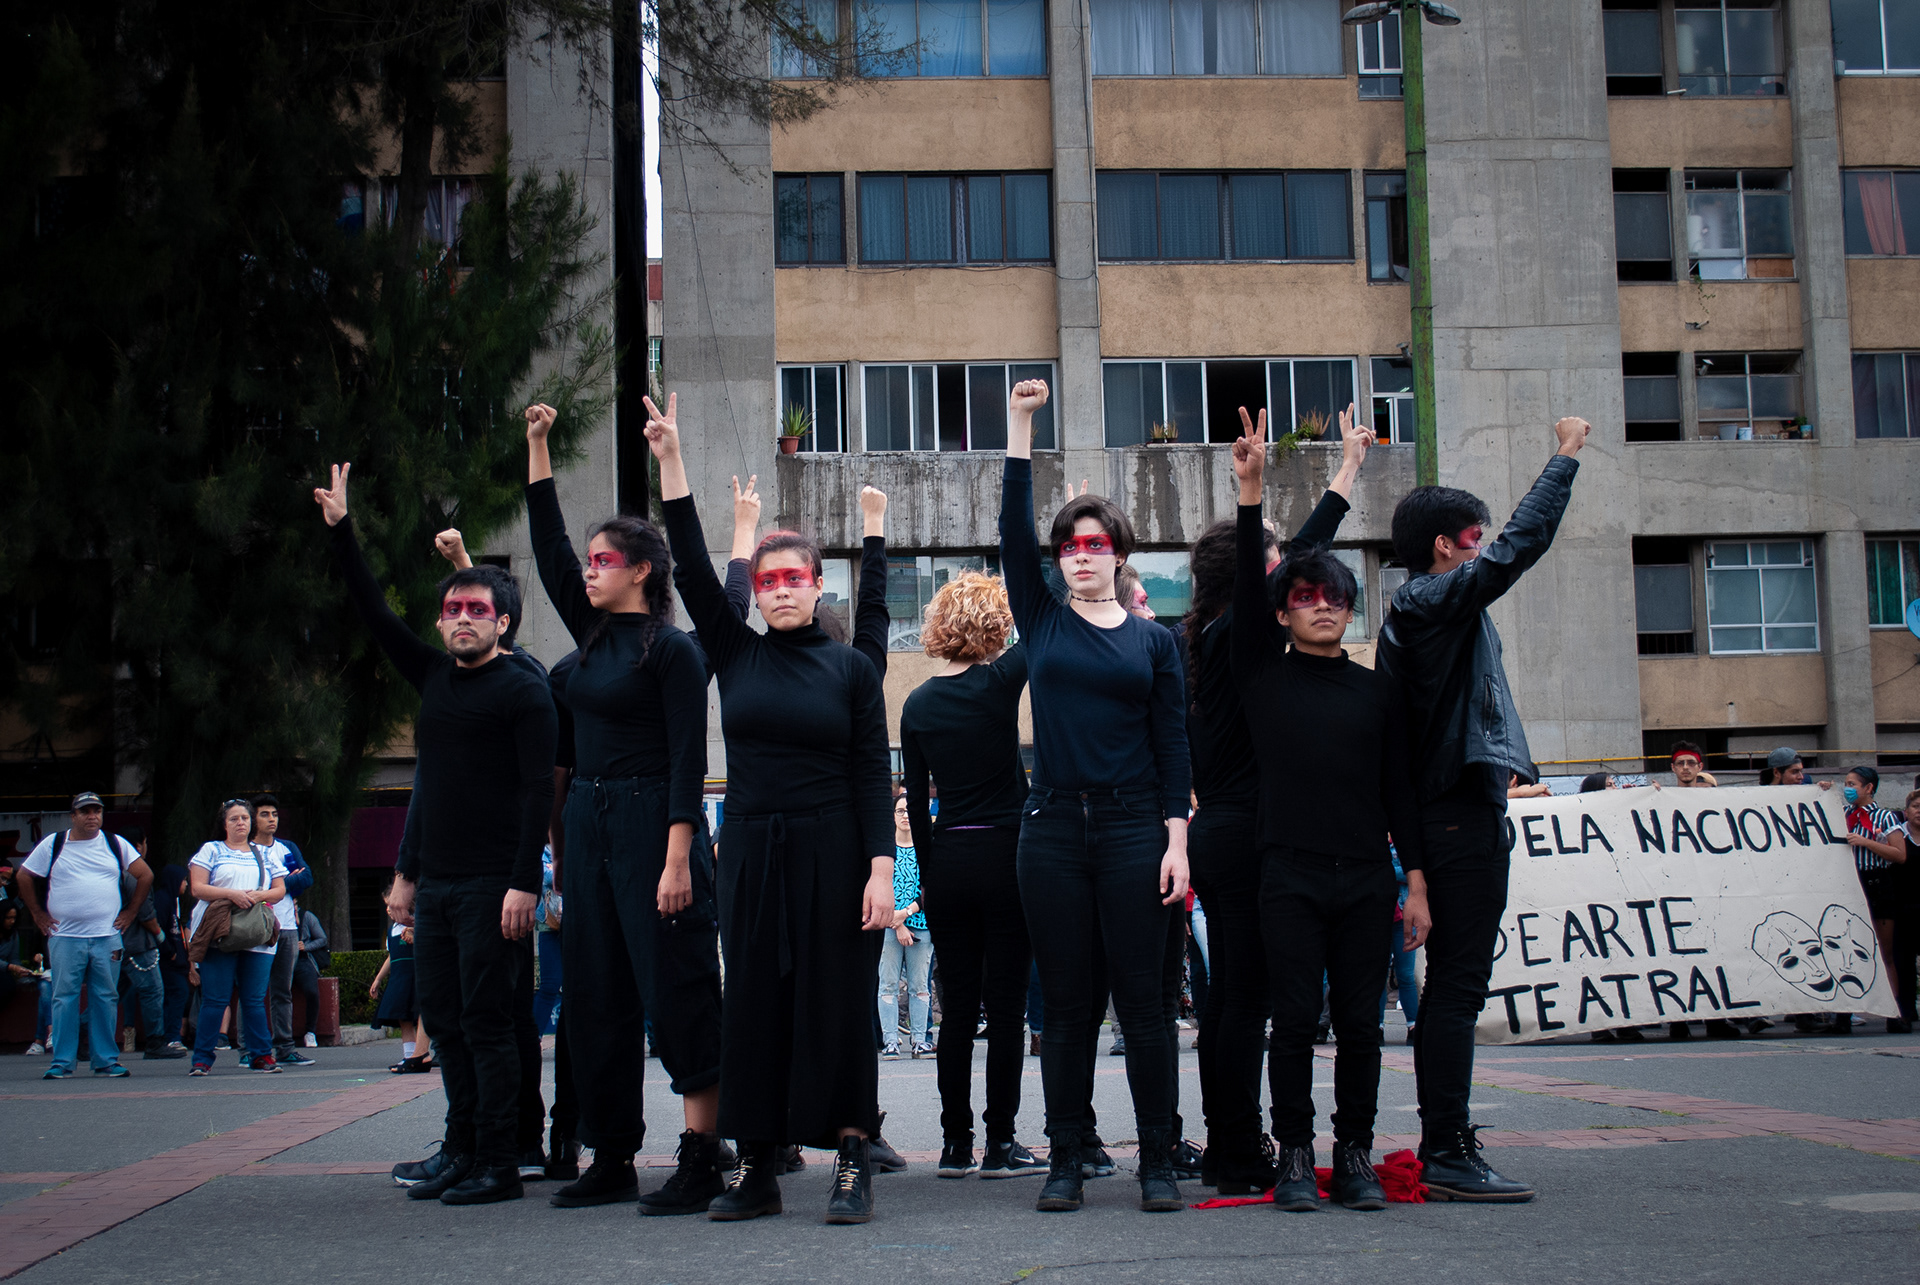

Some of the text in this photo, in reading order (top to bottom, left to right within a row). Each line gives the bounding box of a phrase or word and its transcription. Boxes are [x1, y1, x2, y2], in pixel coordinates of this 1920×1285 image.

[1630, 800, 1848, 854] NACIONAL
[1562, 896, 1708, 963] ARTE
[1486, 965, 1761, 1034] TEATRAL
